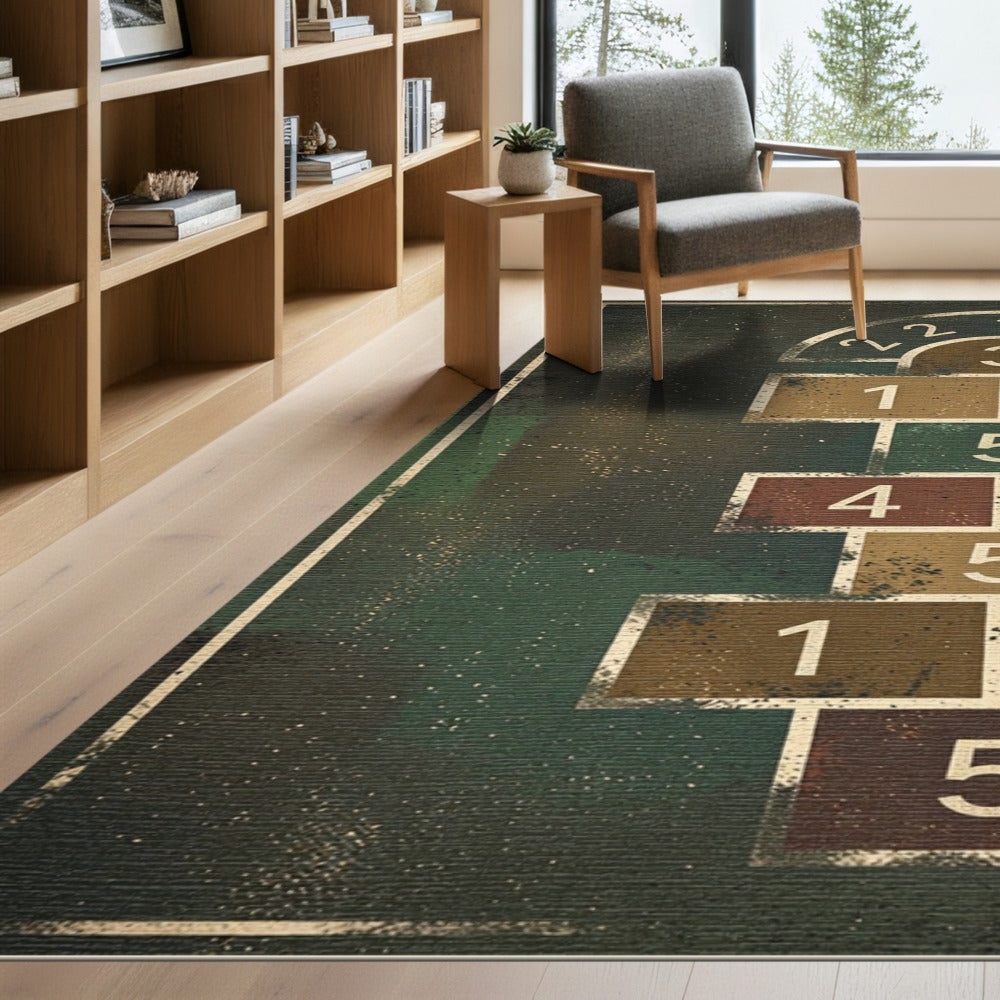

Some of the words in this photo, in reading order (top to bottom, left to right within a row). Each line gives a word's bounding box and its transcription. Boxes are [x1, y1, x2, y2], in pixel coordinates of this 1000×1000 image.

[903, 323, 957, 338] 2
[864, 385, 899, 410] 1
[827, 485, 902, 519] 4
[778, 620, 830, 676] 1
